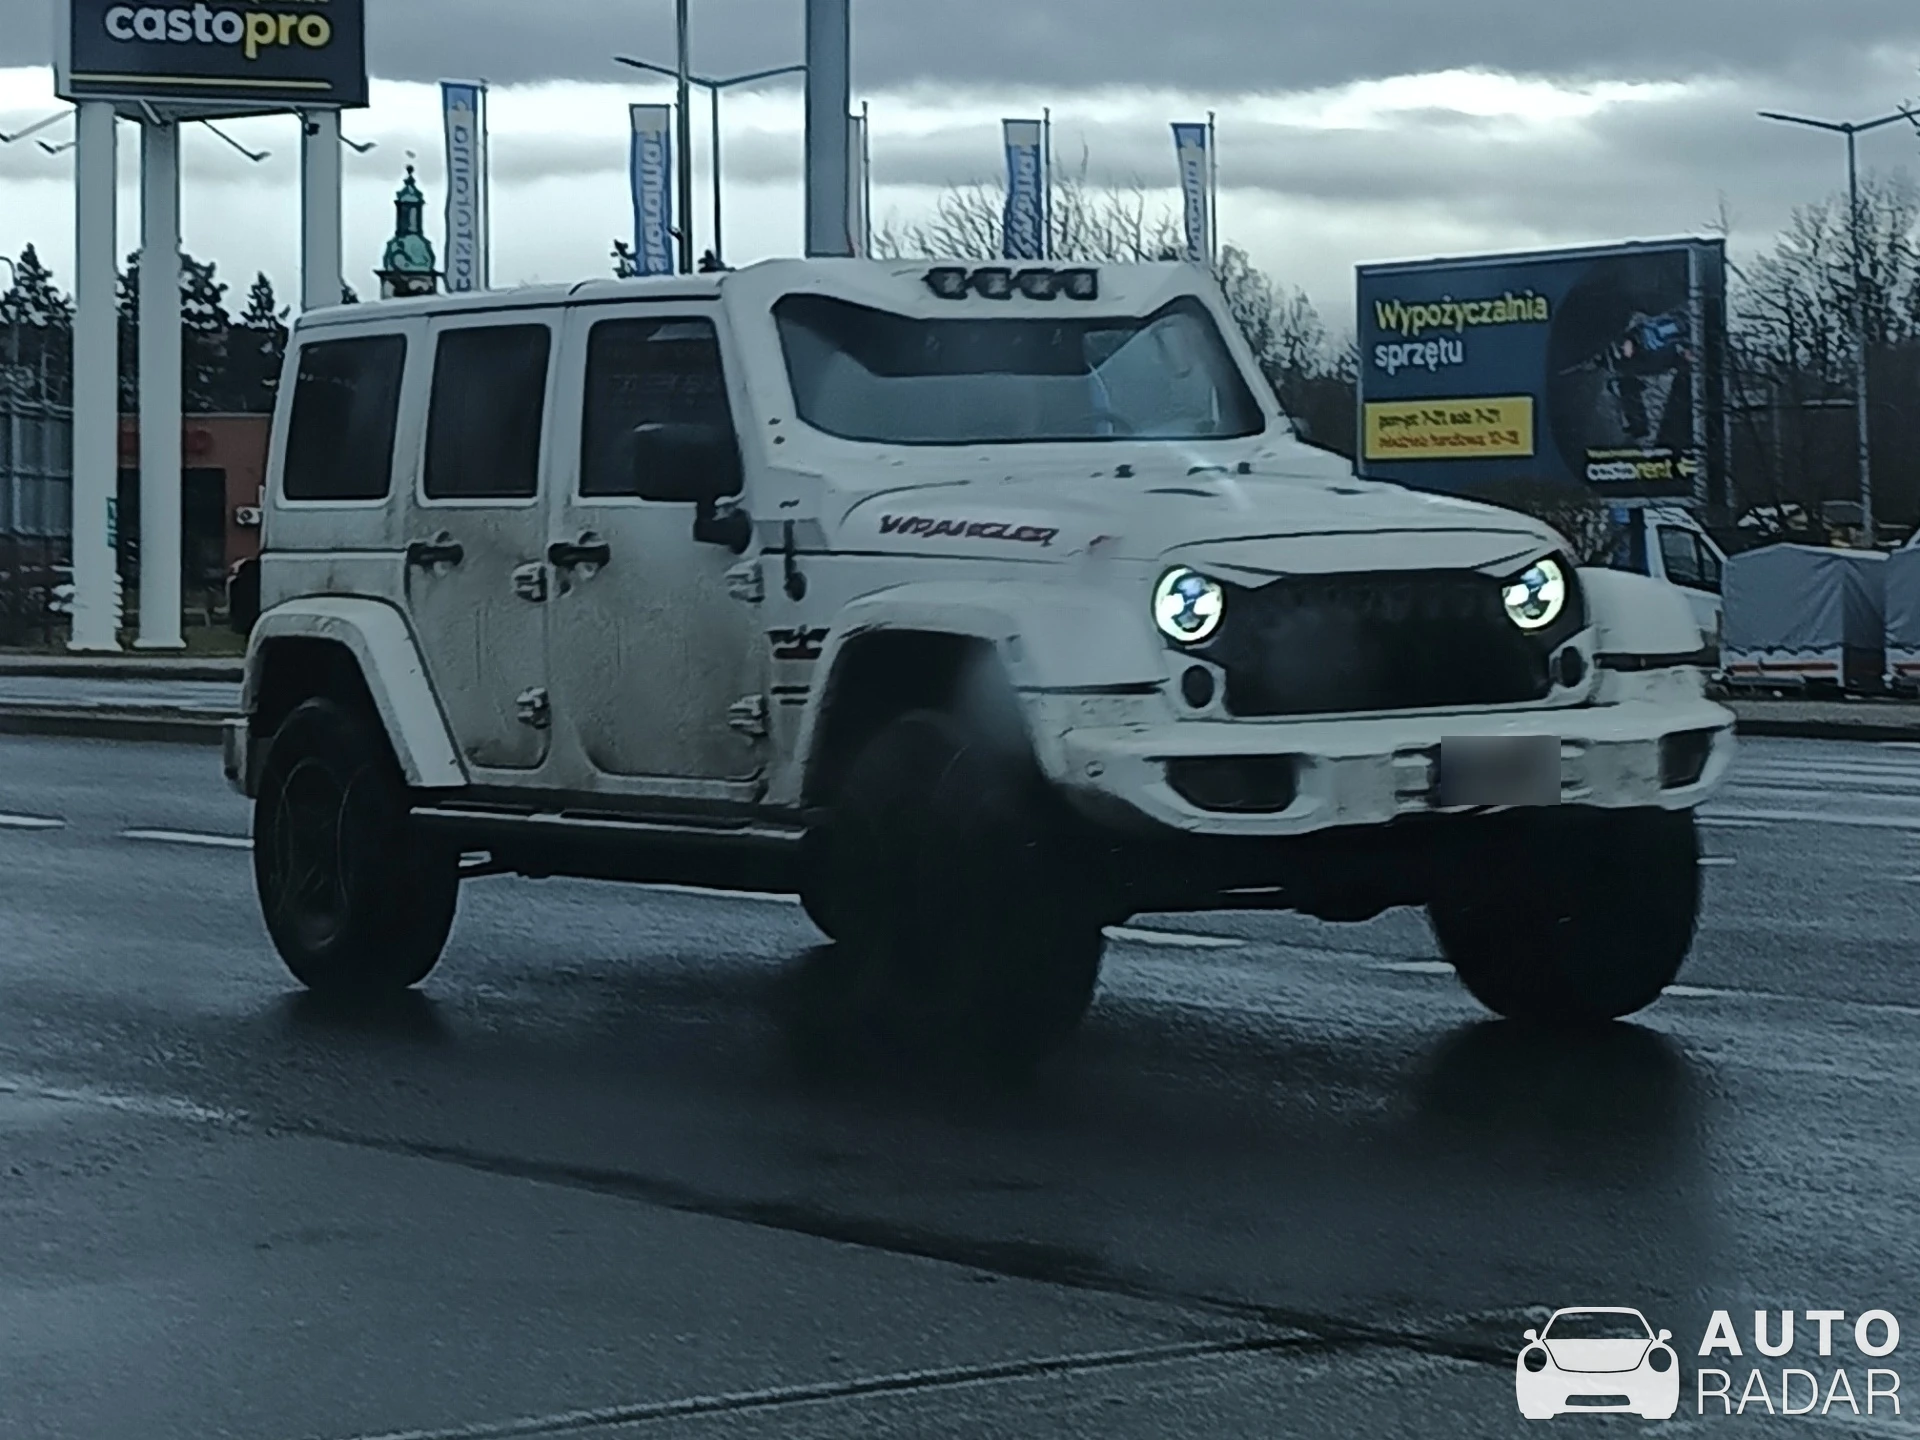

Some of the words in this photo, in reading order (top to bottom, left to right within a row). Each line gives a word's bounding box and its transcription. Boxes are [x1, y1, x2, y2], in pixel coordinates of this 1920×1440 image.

[105, 3, 331, 59] castopro
[1375, 290, 1548, 337] Wypożyczalnia
[1375, 337, 1464, 376] sprzętu
